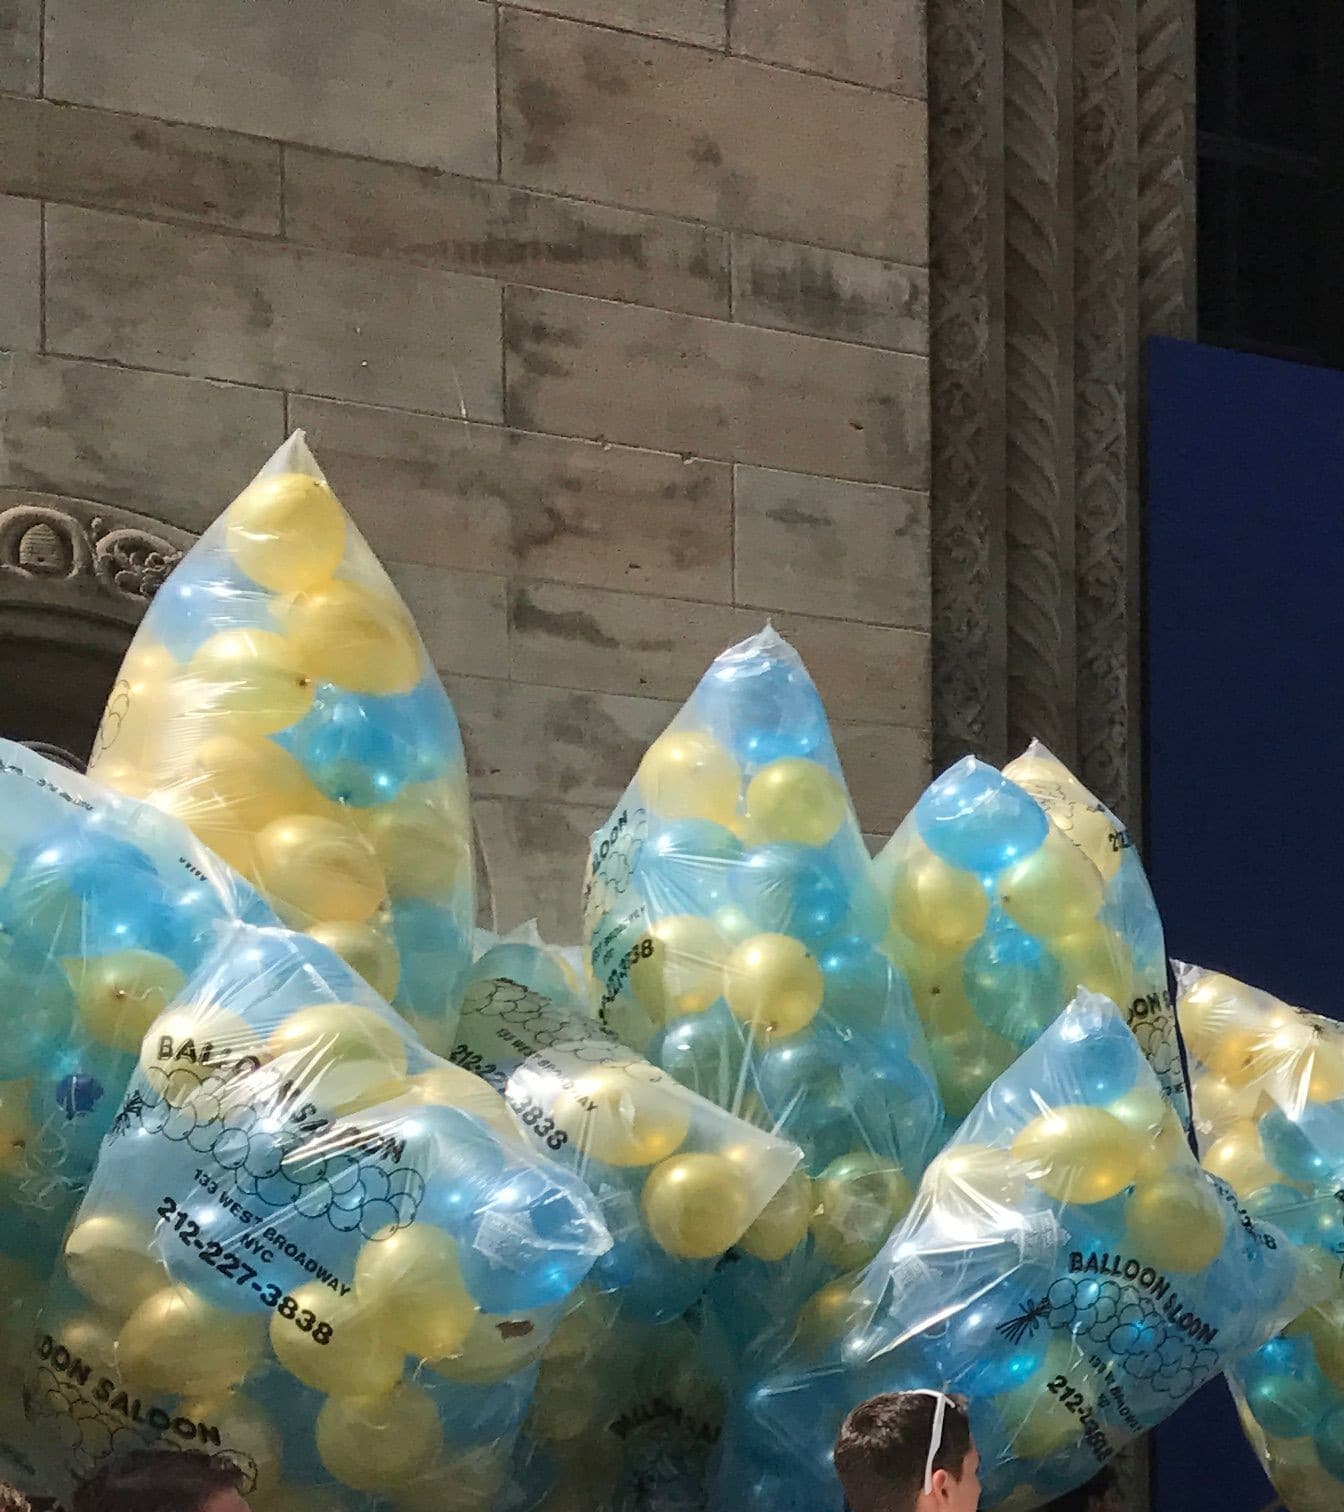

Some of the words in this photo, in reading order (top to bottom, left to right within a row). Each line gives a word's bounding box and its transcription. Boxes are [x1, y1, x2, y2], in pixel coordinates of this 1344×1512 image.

[157, 1197, 333, 1345] 212-227-3838
[194, 1168, 218, 1194] 133
[218, 1191, 263, 1225] WEST
[262, 1227, 350, 1297] BROADWAY
[240, 1233, 274, 1263] NYC
[1068, 1251, 1171, 1300] BALLOON
